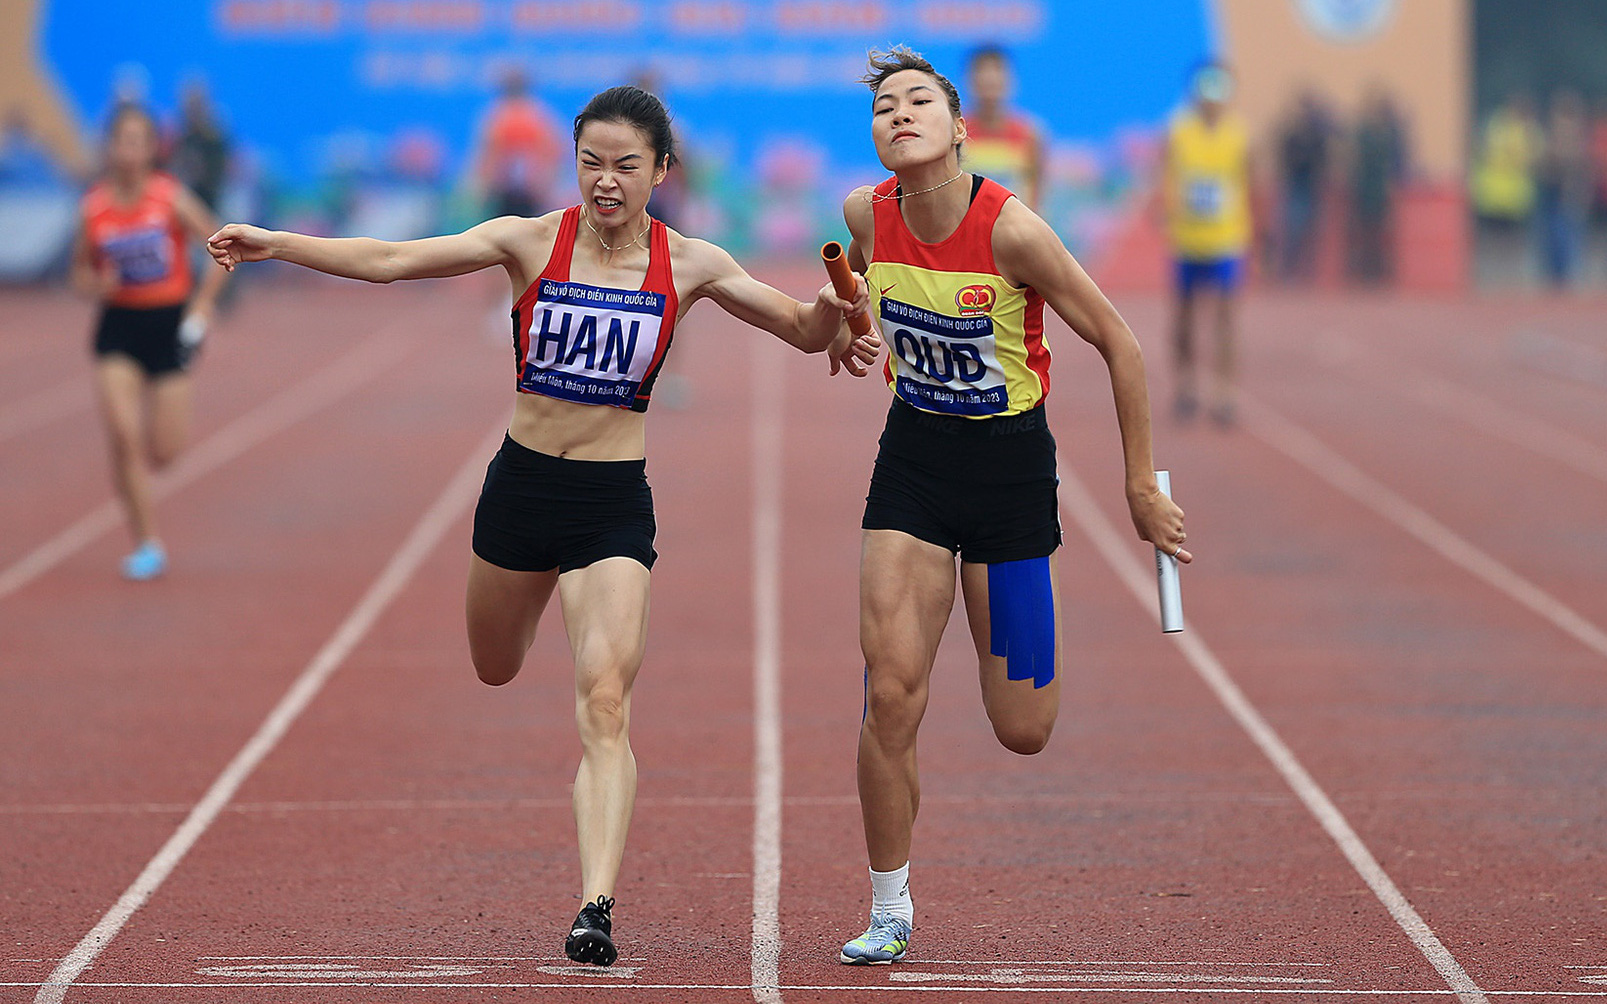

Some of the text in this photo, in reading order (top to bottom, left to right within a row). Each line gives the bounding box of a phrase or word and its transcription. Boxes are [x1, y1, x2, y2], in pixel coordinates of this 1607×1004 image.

[605, 292, 623, 303] KINH
[938, 316, 954, 330] KINH
[975, 319, 989, 329] GIA
[536, 308, 641, 375] HAN
[565, 379, 586, 396] tháng
[587, 384, 597, 395] 10
[933, 390, 955, 404] tháng
[981, 391, 1001, 403] 2023
[990, 413, 1036, 437] NIKE
